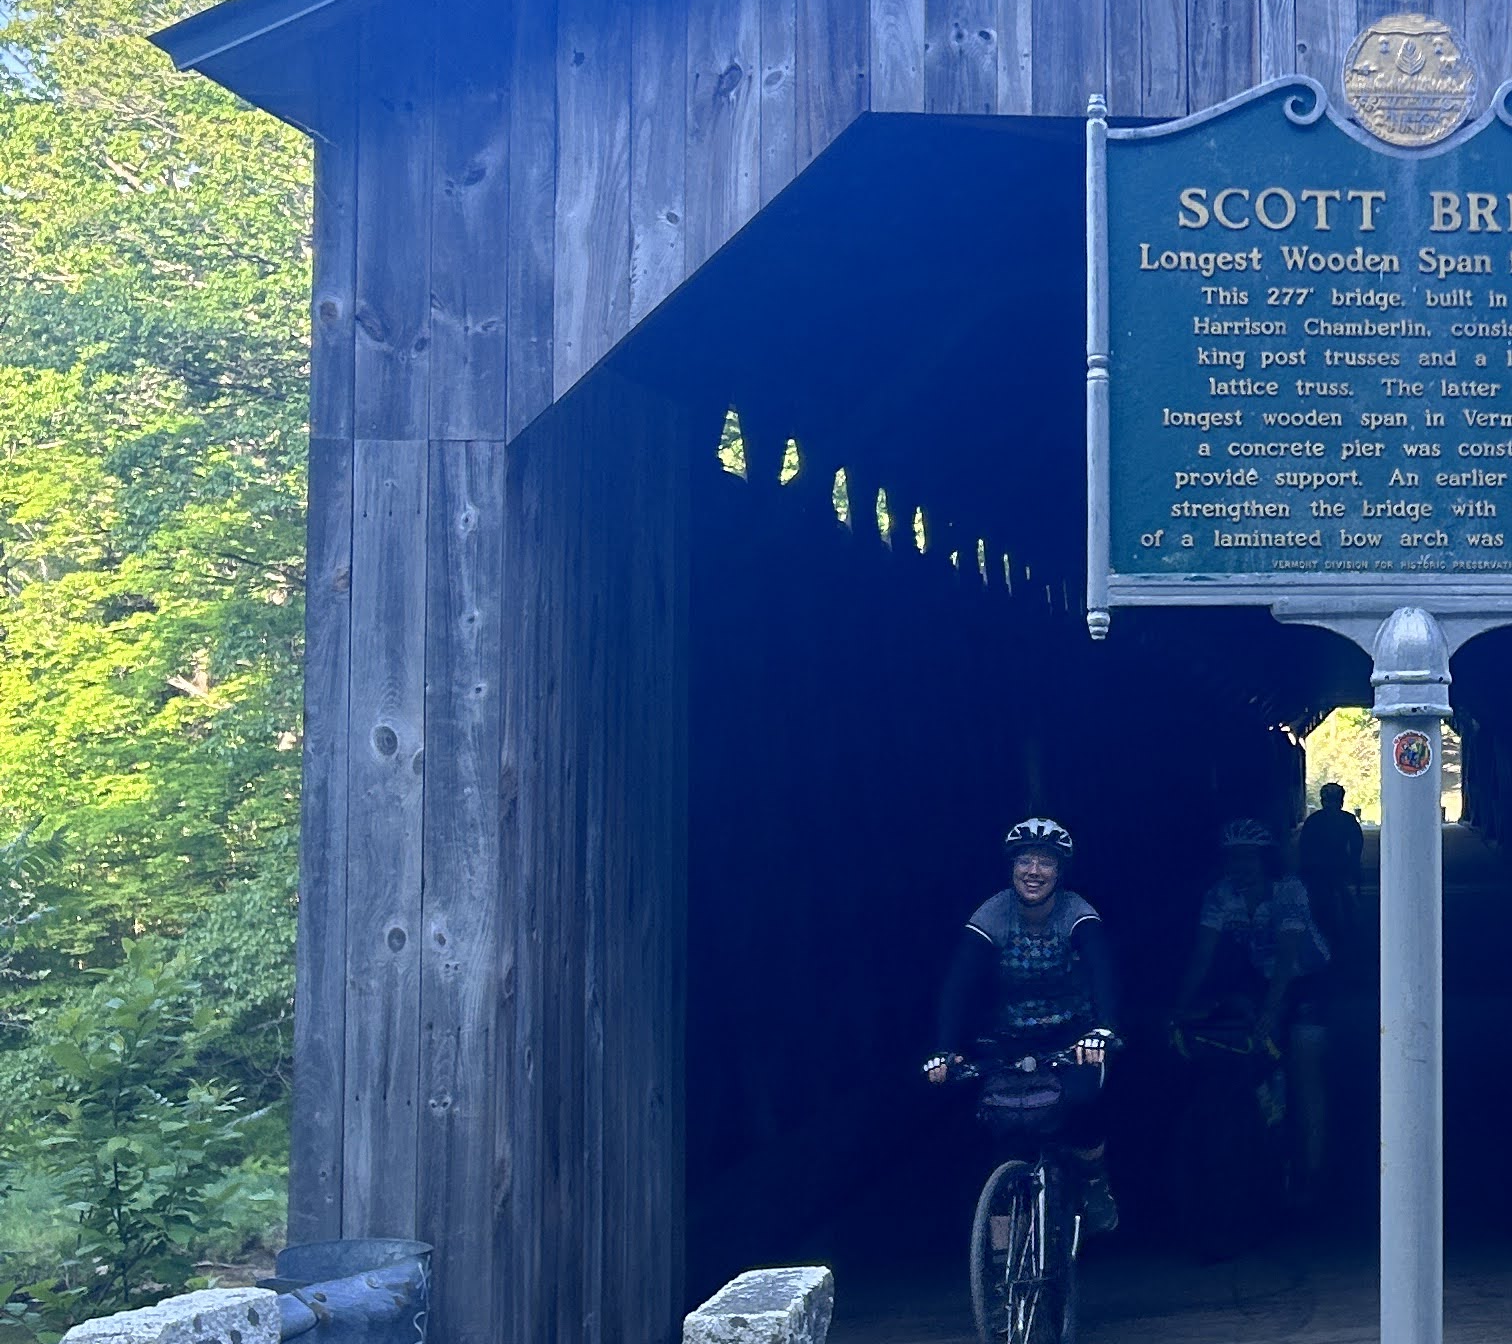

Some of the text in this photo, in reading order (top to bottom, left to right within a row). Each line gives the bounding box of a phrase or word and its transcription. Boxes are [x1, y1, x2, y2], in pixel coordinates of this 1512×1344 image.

[1178, 187, 1387, 231] SCOTT
[1140, 243, 1262, 277] Longest
[1281, 245, 1400, 273] Wooden
[1418, 246, 1493, 279] Span
[1201, 286, 1249, 305] This
[1425, 289, 1474, 307] built
[1488, 289, 1508, 307] in
[1193, 317, 1287, 336] Harrison
[1197, 347, 1246, 370] king
[1261, 348, 1307, 369] post
[1324, 348, 1400, 366] trusses
[1418, 349, 1457, 367] and
[1474, 352, 1487, 367] a
[1209, 376, 1279, 396] lattice
[1295, 378, 1354, 397] truss.
[1382, 378, 1425, 397] The
[1441, 378, 1501, 397] latter
[1162, 408, 1243, 431] longest
[1262, 409, 1343, 427] wooden
[1360, 411, 1408, 431] span
[1424, 408, 1445, 427] in
[1198, 441, 1211, 457] a
[1227, 440, 1325, 457] concrete
[1341, 439, 1386, 460] pier
[1403, 441, 1441, 457] was
[1175, 467, 1259, 489] provide
[1275, 469, 1364, 490] support.
[1388, 468, 1419, 486] An
[1436, 468, 1507, 487] earlier
[1171, 499, 1290, 523] strengthen
[1310, 499, 1346, 517] the
[1362, 499, 1433, 522] bridge
[1451, 499, 1497, 517] with
[1141, 529, 1165, 547] of
[1181, 532, 1195, 547] a
[1214, 529, 1322, 548] laminated
[1340, 529, 1383, 547] bow
[1400, 529, 1449, 547] arch
[1466, 532, 1504, 548] was
[1272, 559, 1319, 569] VERMONT
[1324, 559, 1369, 570] DIVISION
[1374, 560, 1394, 569] FOR
[1400, 560, 1446, 570] HISTORIC
